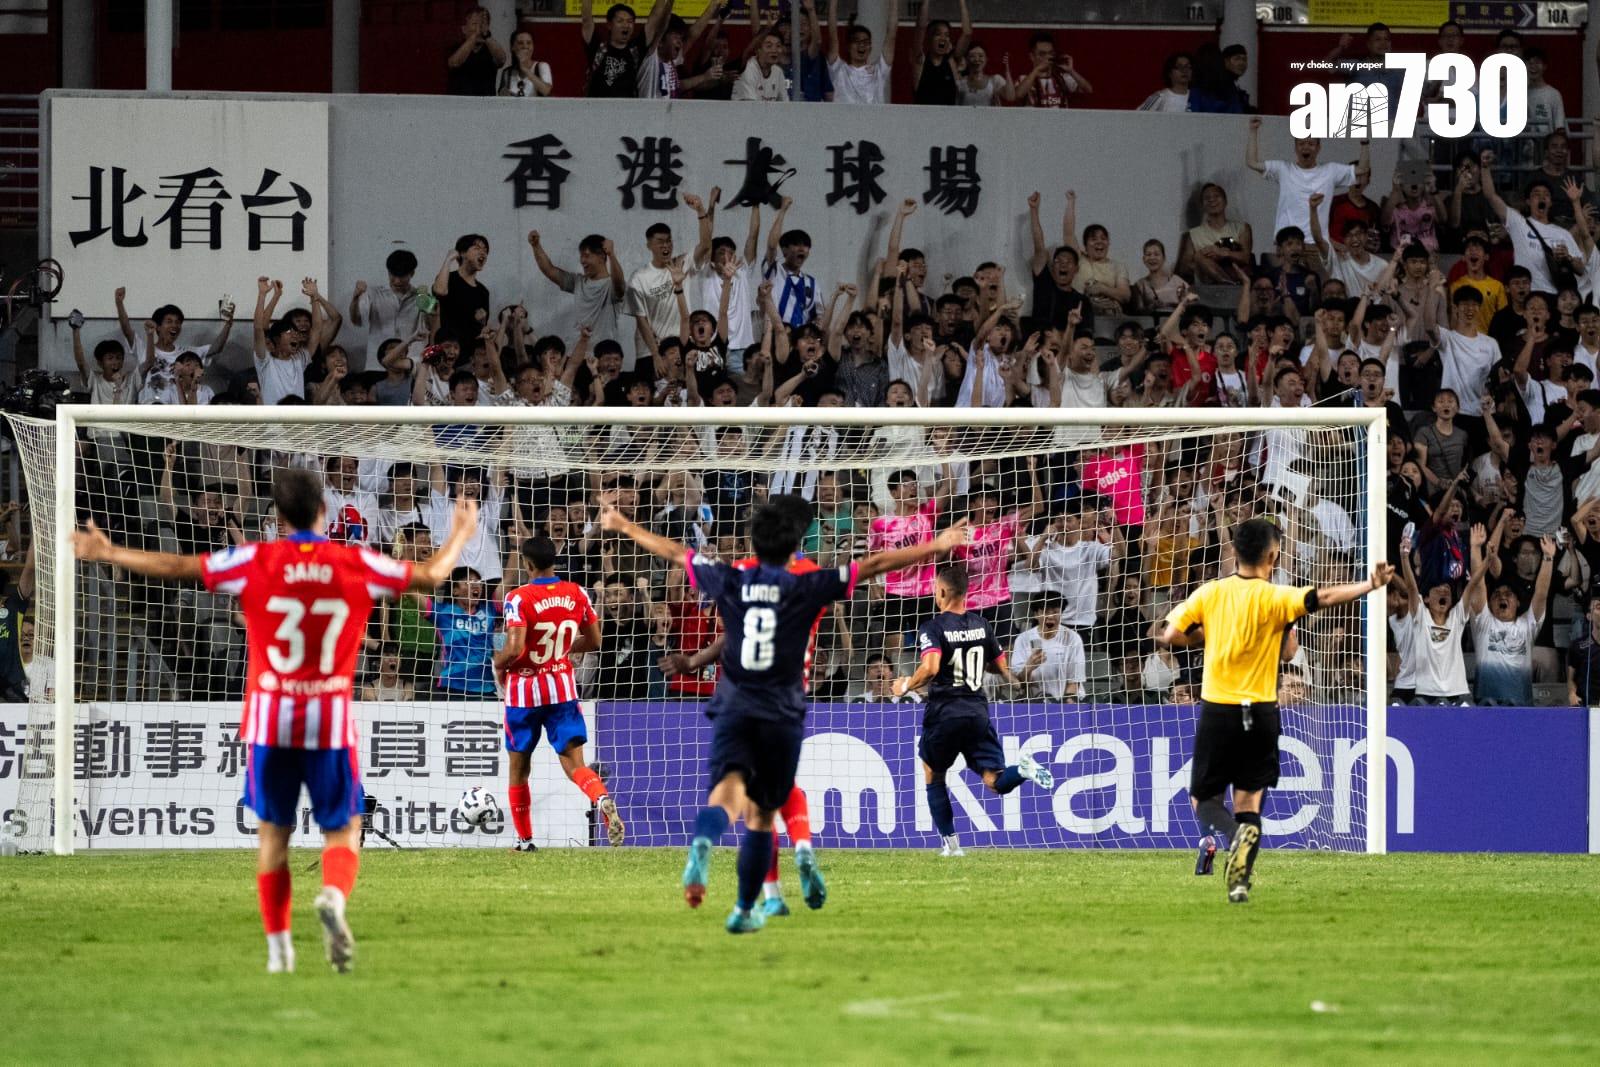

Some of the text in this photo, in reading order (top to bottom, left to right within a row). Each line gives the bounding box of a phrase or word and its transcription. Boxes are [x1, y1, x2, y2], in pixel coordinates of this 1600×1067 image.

[1273, 7, 1293, 21] 10B
[1548, 9, 1569, 24] 10A
[68, 166, 313, 252] 北看台
[533, 595, 577, 615] MOURIÑO
[265, 596, 350, 675] 37
[529, 619, 579, 665] 30
[740, 606, 778, 672] 8
[943, 627, 987, 643] MACHADO
[947, 645, 985, 692] 10
